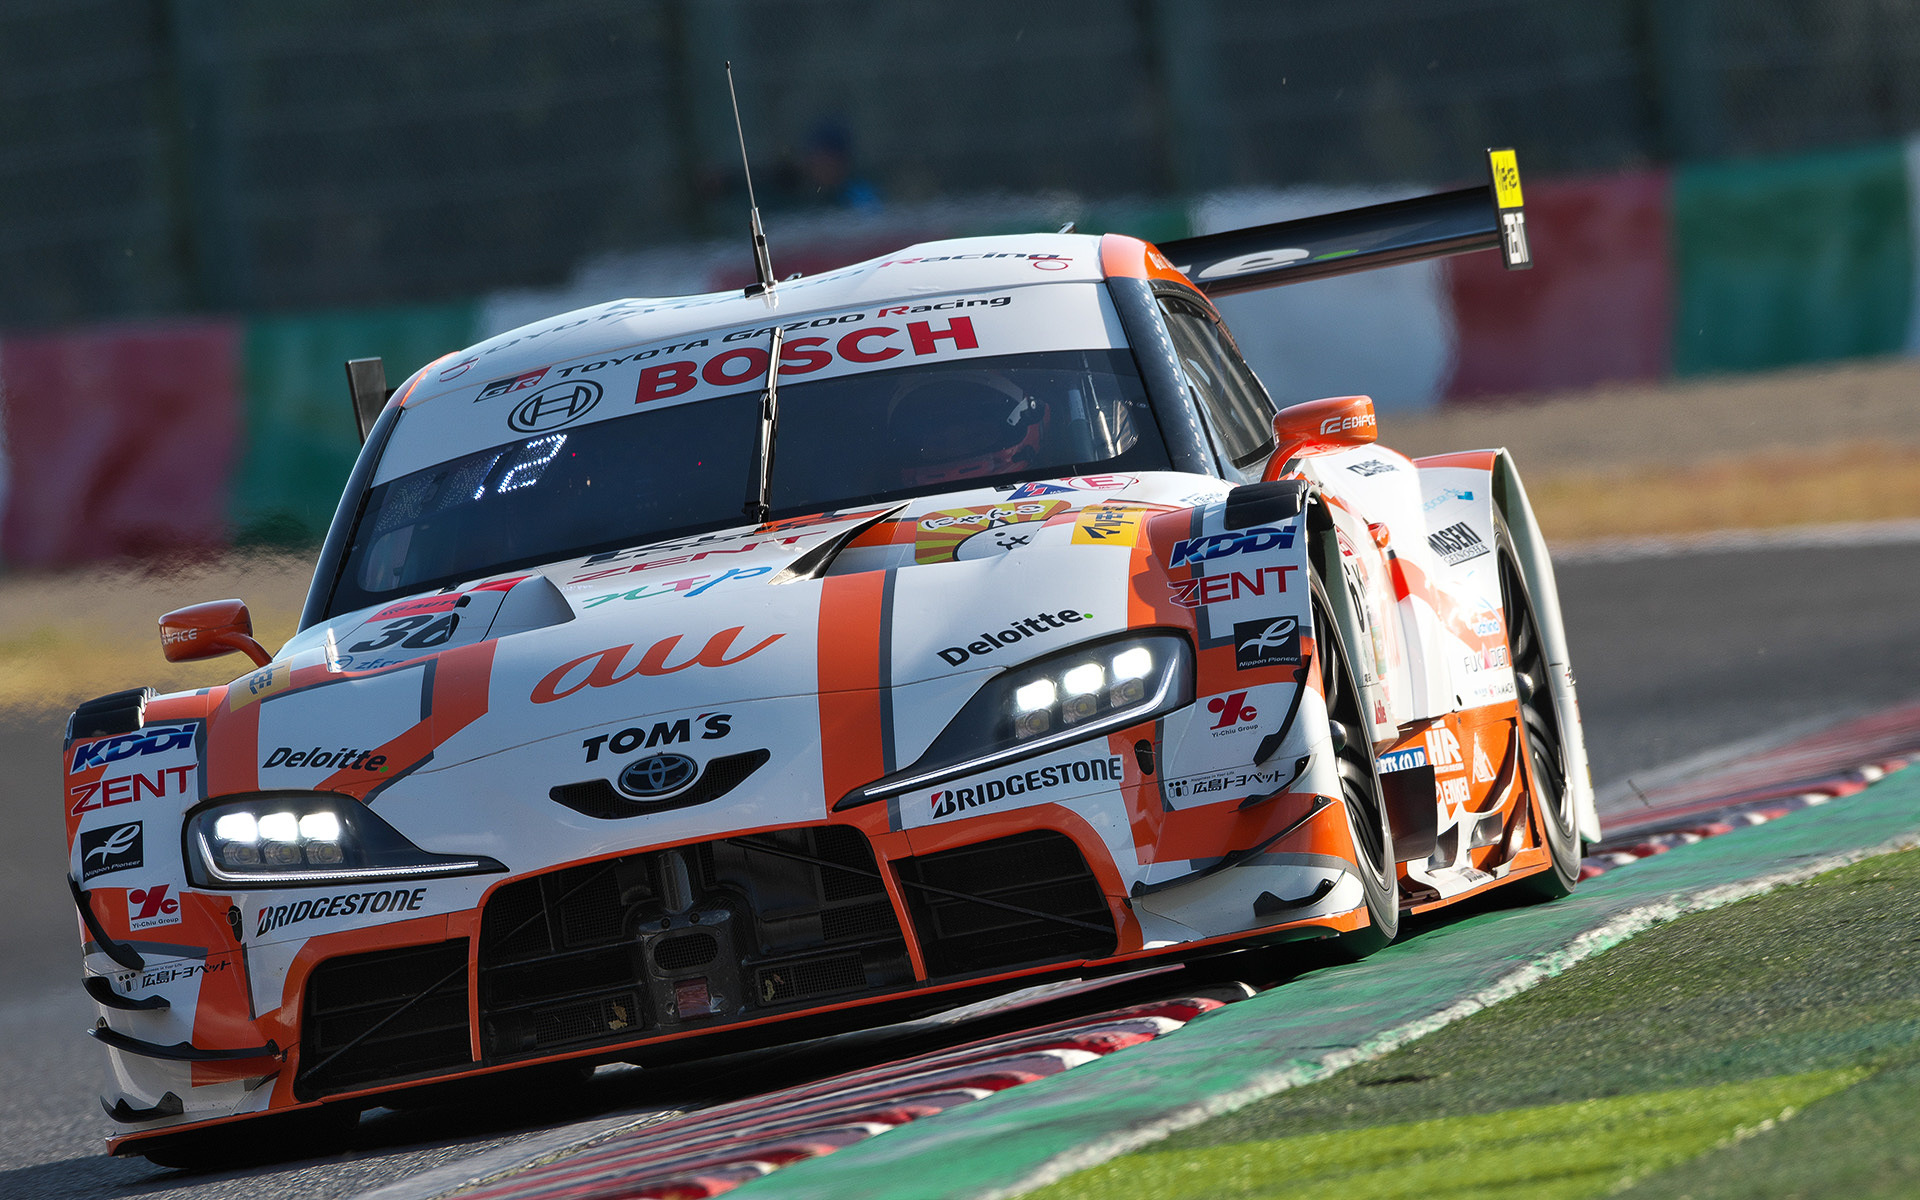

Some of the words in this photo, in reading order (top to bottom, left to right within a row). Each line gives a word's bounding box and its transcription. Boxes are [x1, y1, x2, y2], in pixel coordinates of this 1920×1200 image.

[556, 339, 709, 378] TOYOTA
[722, 313, 865, 342] GAZOO
[877, 296, 1011, 318] Racing
[635, 316, 979, 404] BOSCH
[567, 531, 827, 585] ZENT
[1169, 526, 1297, 568] KDDI
[1427, 521, 1482, 557] MASEKI
[1168, 565, 1298, 608] ZENT
[348, 613, 460, 653] 36
[936, 609, 1093, 667] Deloitte.
[530, 625, 787, 703] au
[1239, 659, 1267, 667] Nippon
[70, 722, 199, 775] KDDI
[582, 712, 732, 763] TOM'S
[1212, 728, 1237, 738] Yi-Chiu
[1238, 724, 1259, 733] Group
[262, 747, 389, 773] Deloitte.
[1193, 770, 1286, 794] 広島トヨペット
[71, 762, 199, 816] ZENT
[931, 757, 1123, 819] BRIDGESTONE
[132, 921, 157, 929] Yi-Chiu
[158, 917, 179, 926] Group
[256, 888, 427, 938] BRIDGESTONE
[142, 960, 232, 988] 広島トヨペット
